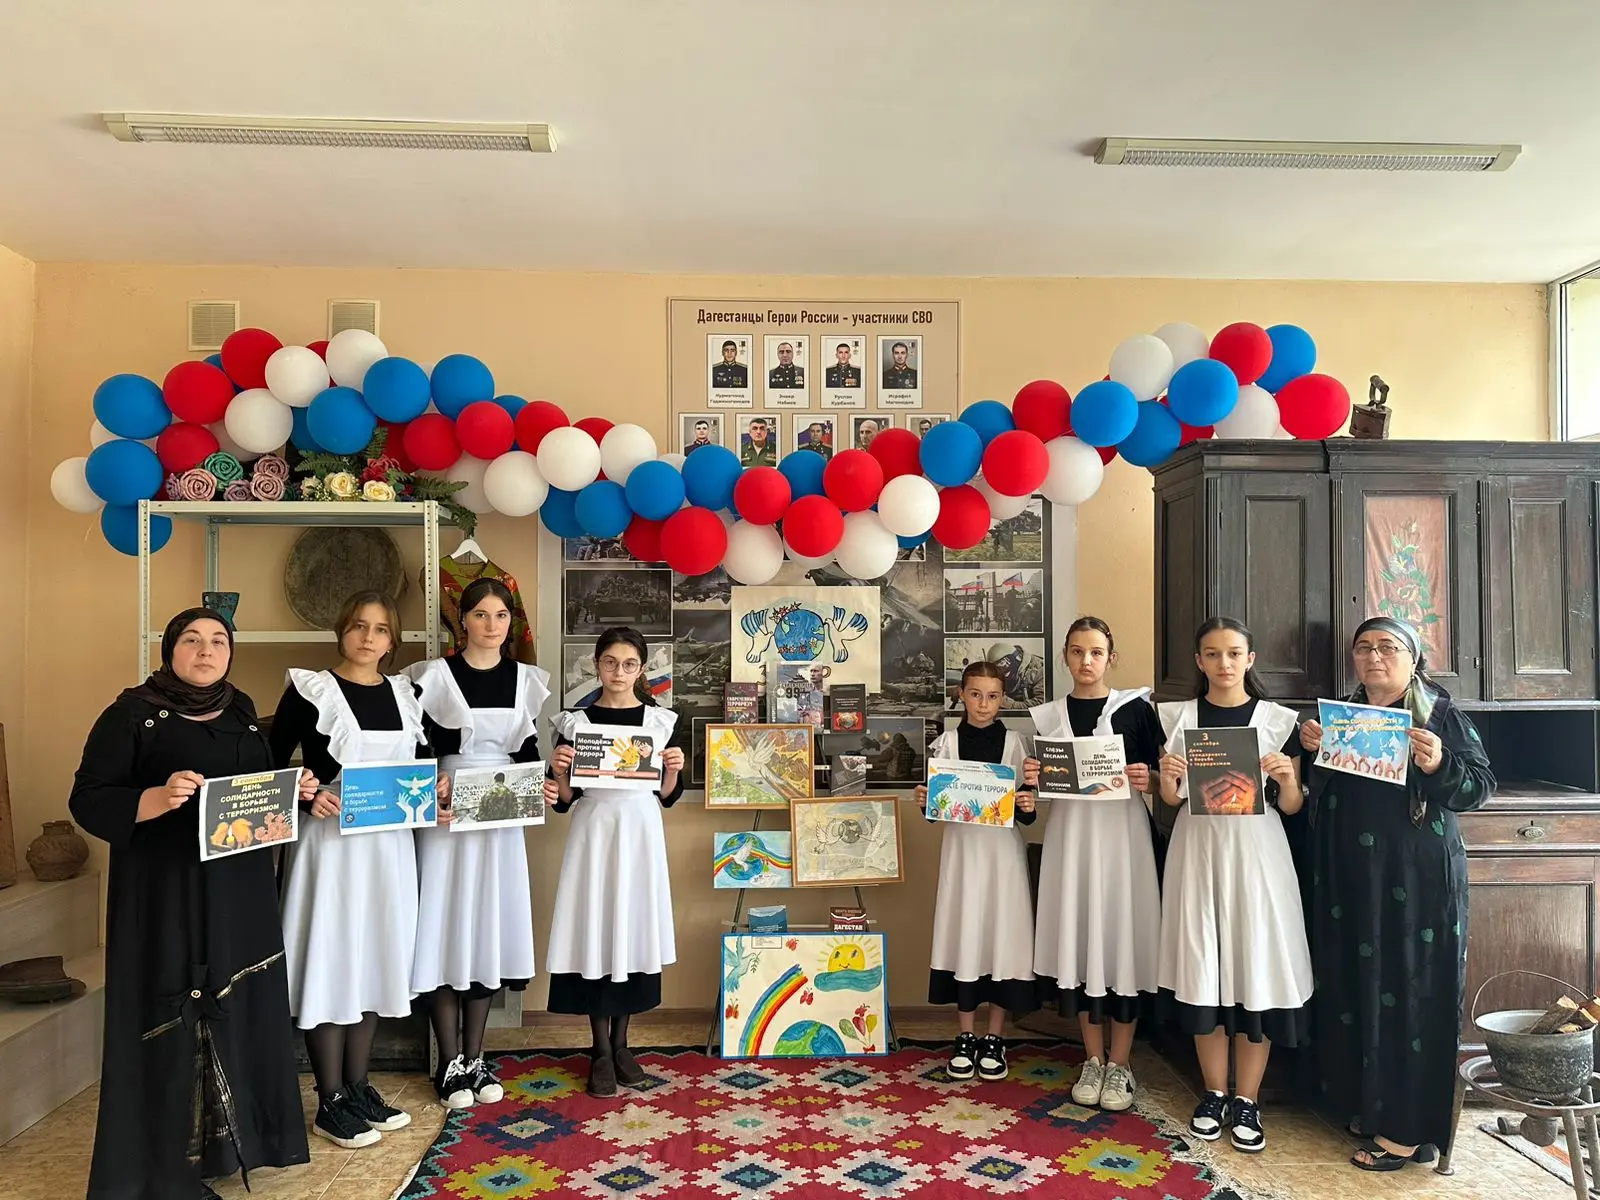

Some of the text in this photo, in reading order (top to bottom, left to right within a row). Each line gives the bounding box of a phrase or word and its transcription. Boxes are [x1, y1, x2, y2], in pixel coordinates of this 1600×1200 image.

[697, 308, 764, 324] Дагестанцы
[767, 309, 797, 326] Герои
[801, 310, 839, 323] России
[852, 313, 908, 327] участники
[912, 310, 933, 323] СВО
[1202, 732, 1209, 741] 3
[576, 750, 604, 758] террора
[1081, 758, 1121, 766] СОЛИДАРНОСТИ
[1086, 769, 1124, 777] ТЕРРОРИЗМОМ
[241, 783, 262, 793] ДЕНЬ
[960, 782, 983, 792] ПРОТИВ
[984, 784, 1008, 794] ТЕРРОРА
[220, 787, 281, 803] СОЛИДАРНОСТИ
[239, 797, 269, 808] БОРЬБЕ
[226, 803, 280, 818] ТЕРРОРИЗМОМ
